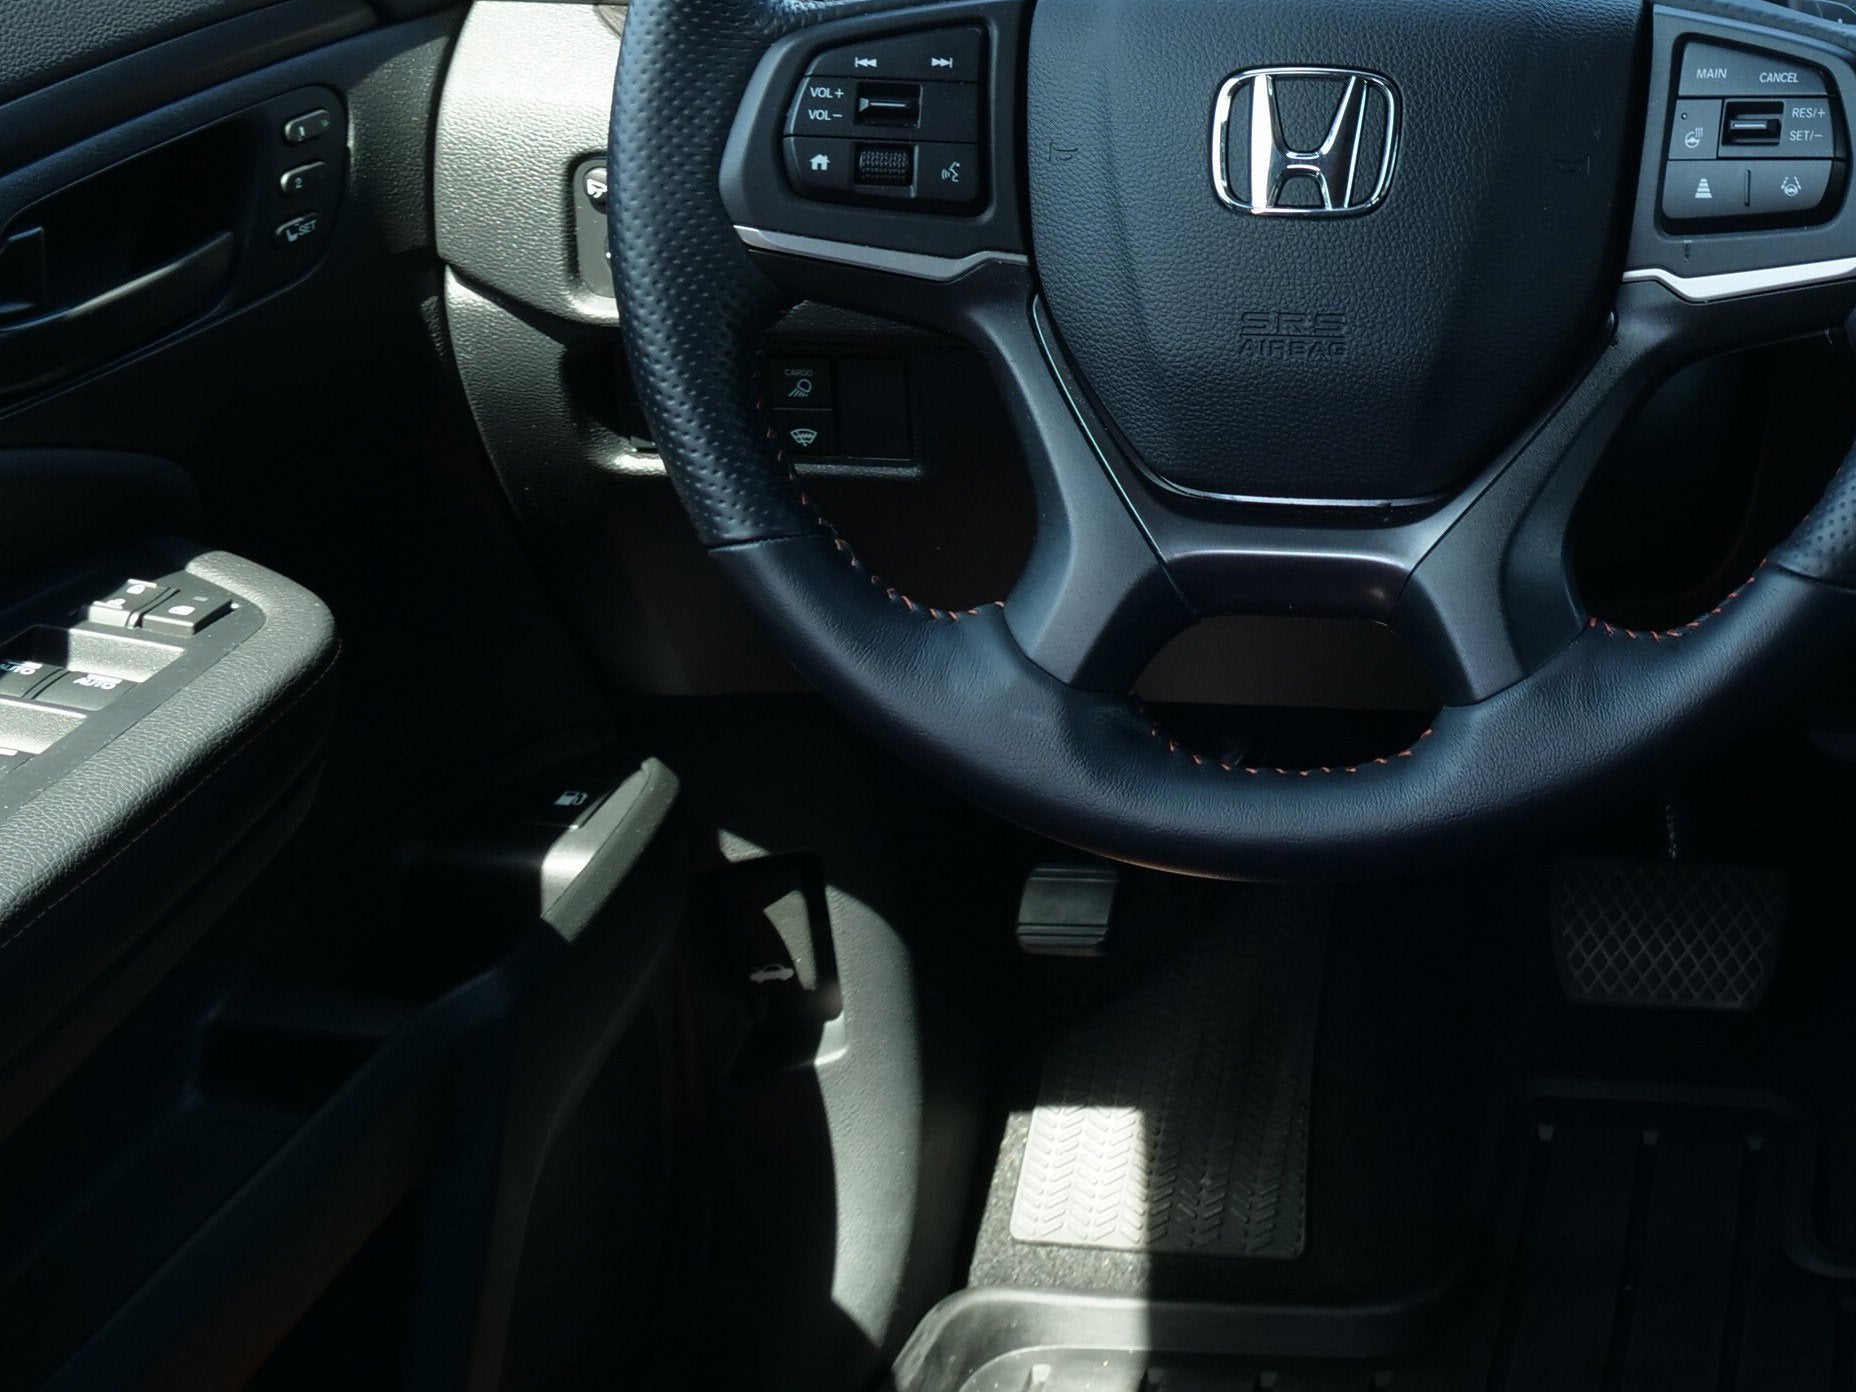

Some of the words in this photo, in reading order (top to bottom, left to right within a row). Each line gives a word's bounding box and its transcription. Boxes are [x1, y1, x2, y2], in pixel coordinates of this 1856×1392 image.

[1696, 68, 1727, 79] MAIN
[1759, 72, 1799, 83] CANCEL
[294, 177, 303, 189] 2
[298, 219, 317, 237] SET
[1240, 310, 1347, 335] SRS
[72, 677, 117, 691] AUTO
